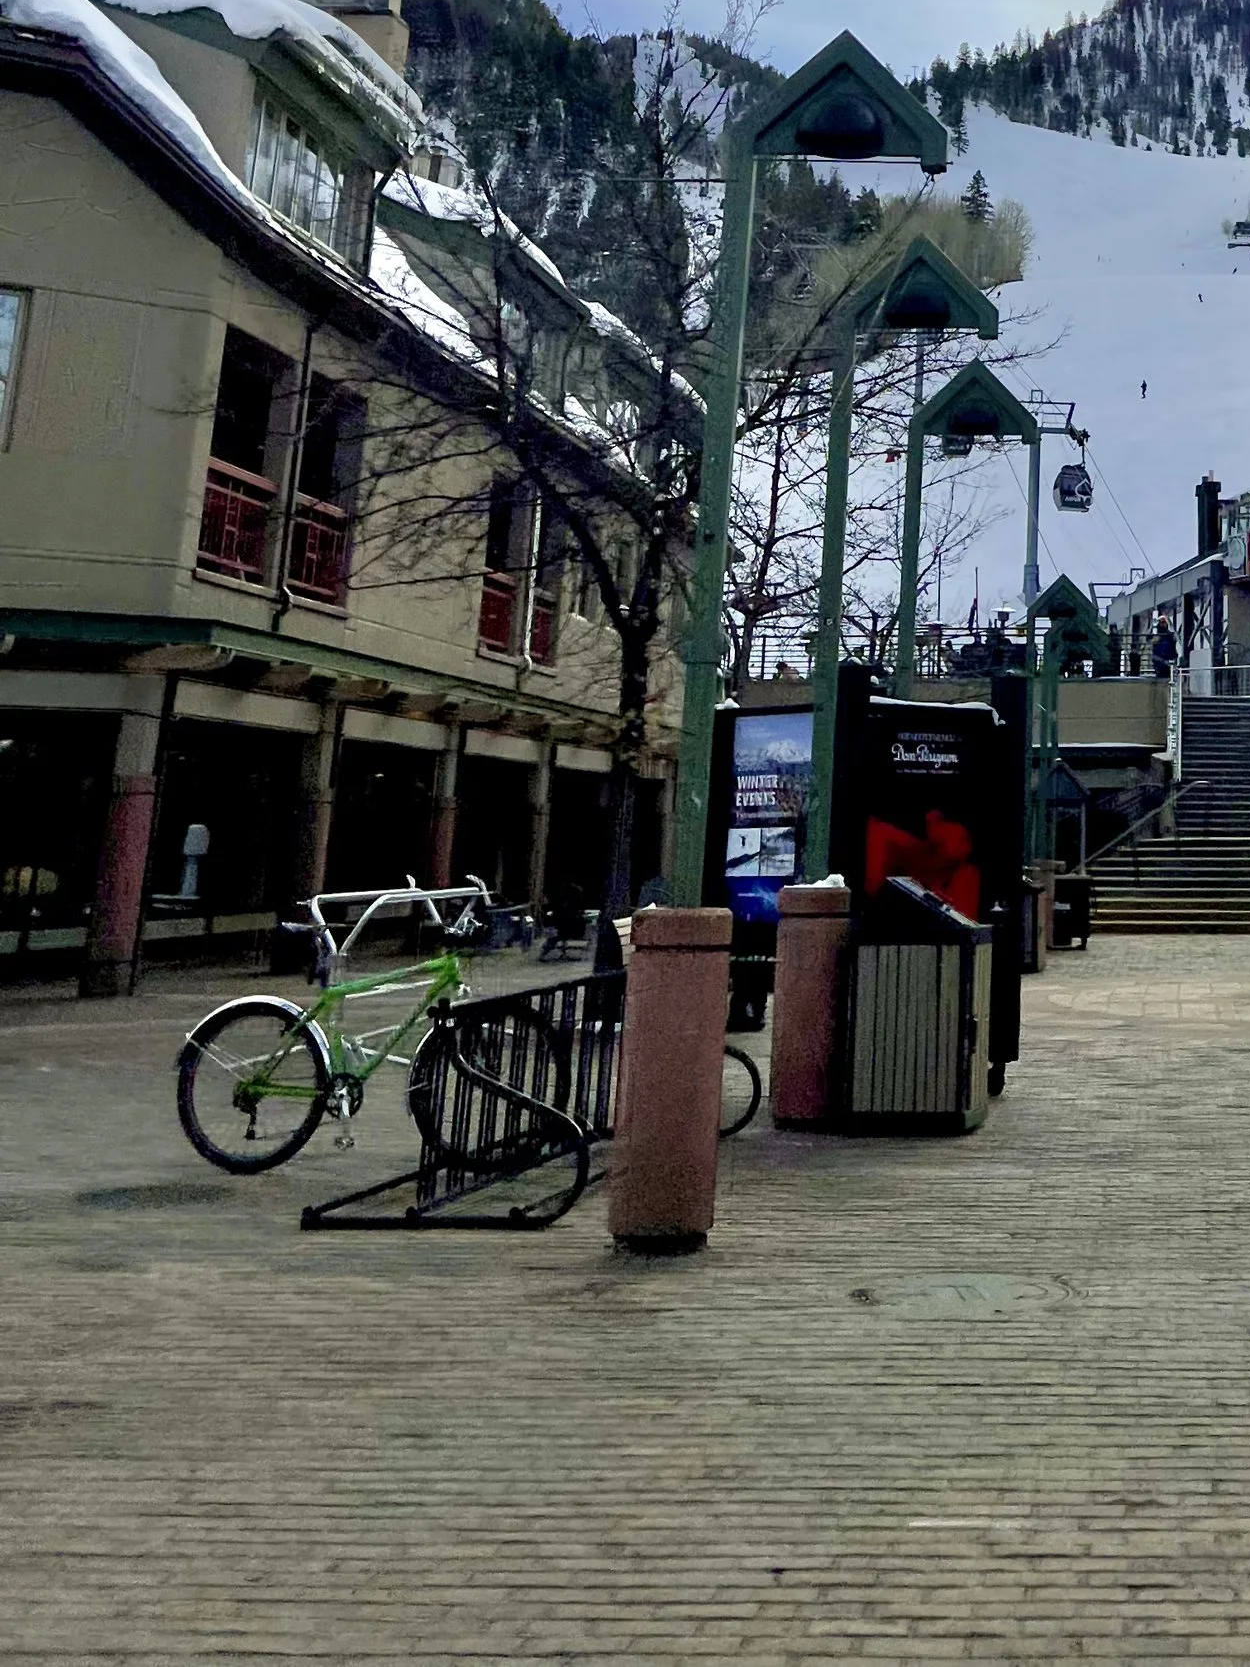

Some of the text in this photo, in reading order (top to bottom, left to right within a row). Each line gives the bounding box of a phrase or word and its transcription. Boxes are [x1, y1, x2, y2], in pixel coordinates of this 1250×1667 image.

[891, 743, 916, 762] Dom
[737, 774, 778, 790] WINTER
[736, 791, 776, 807] EVENTS
